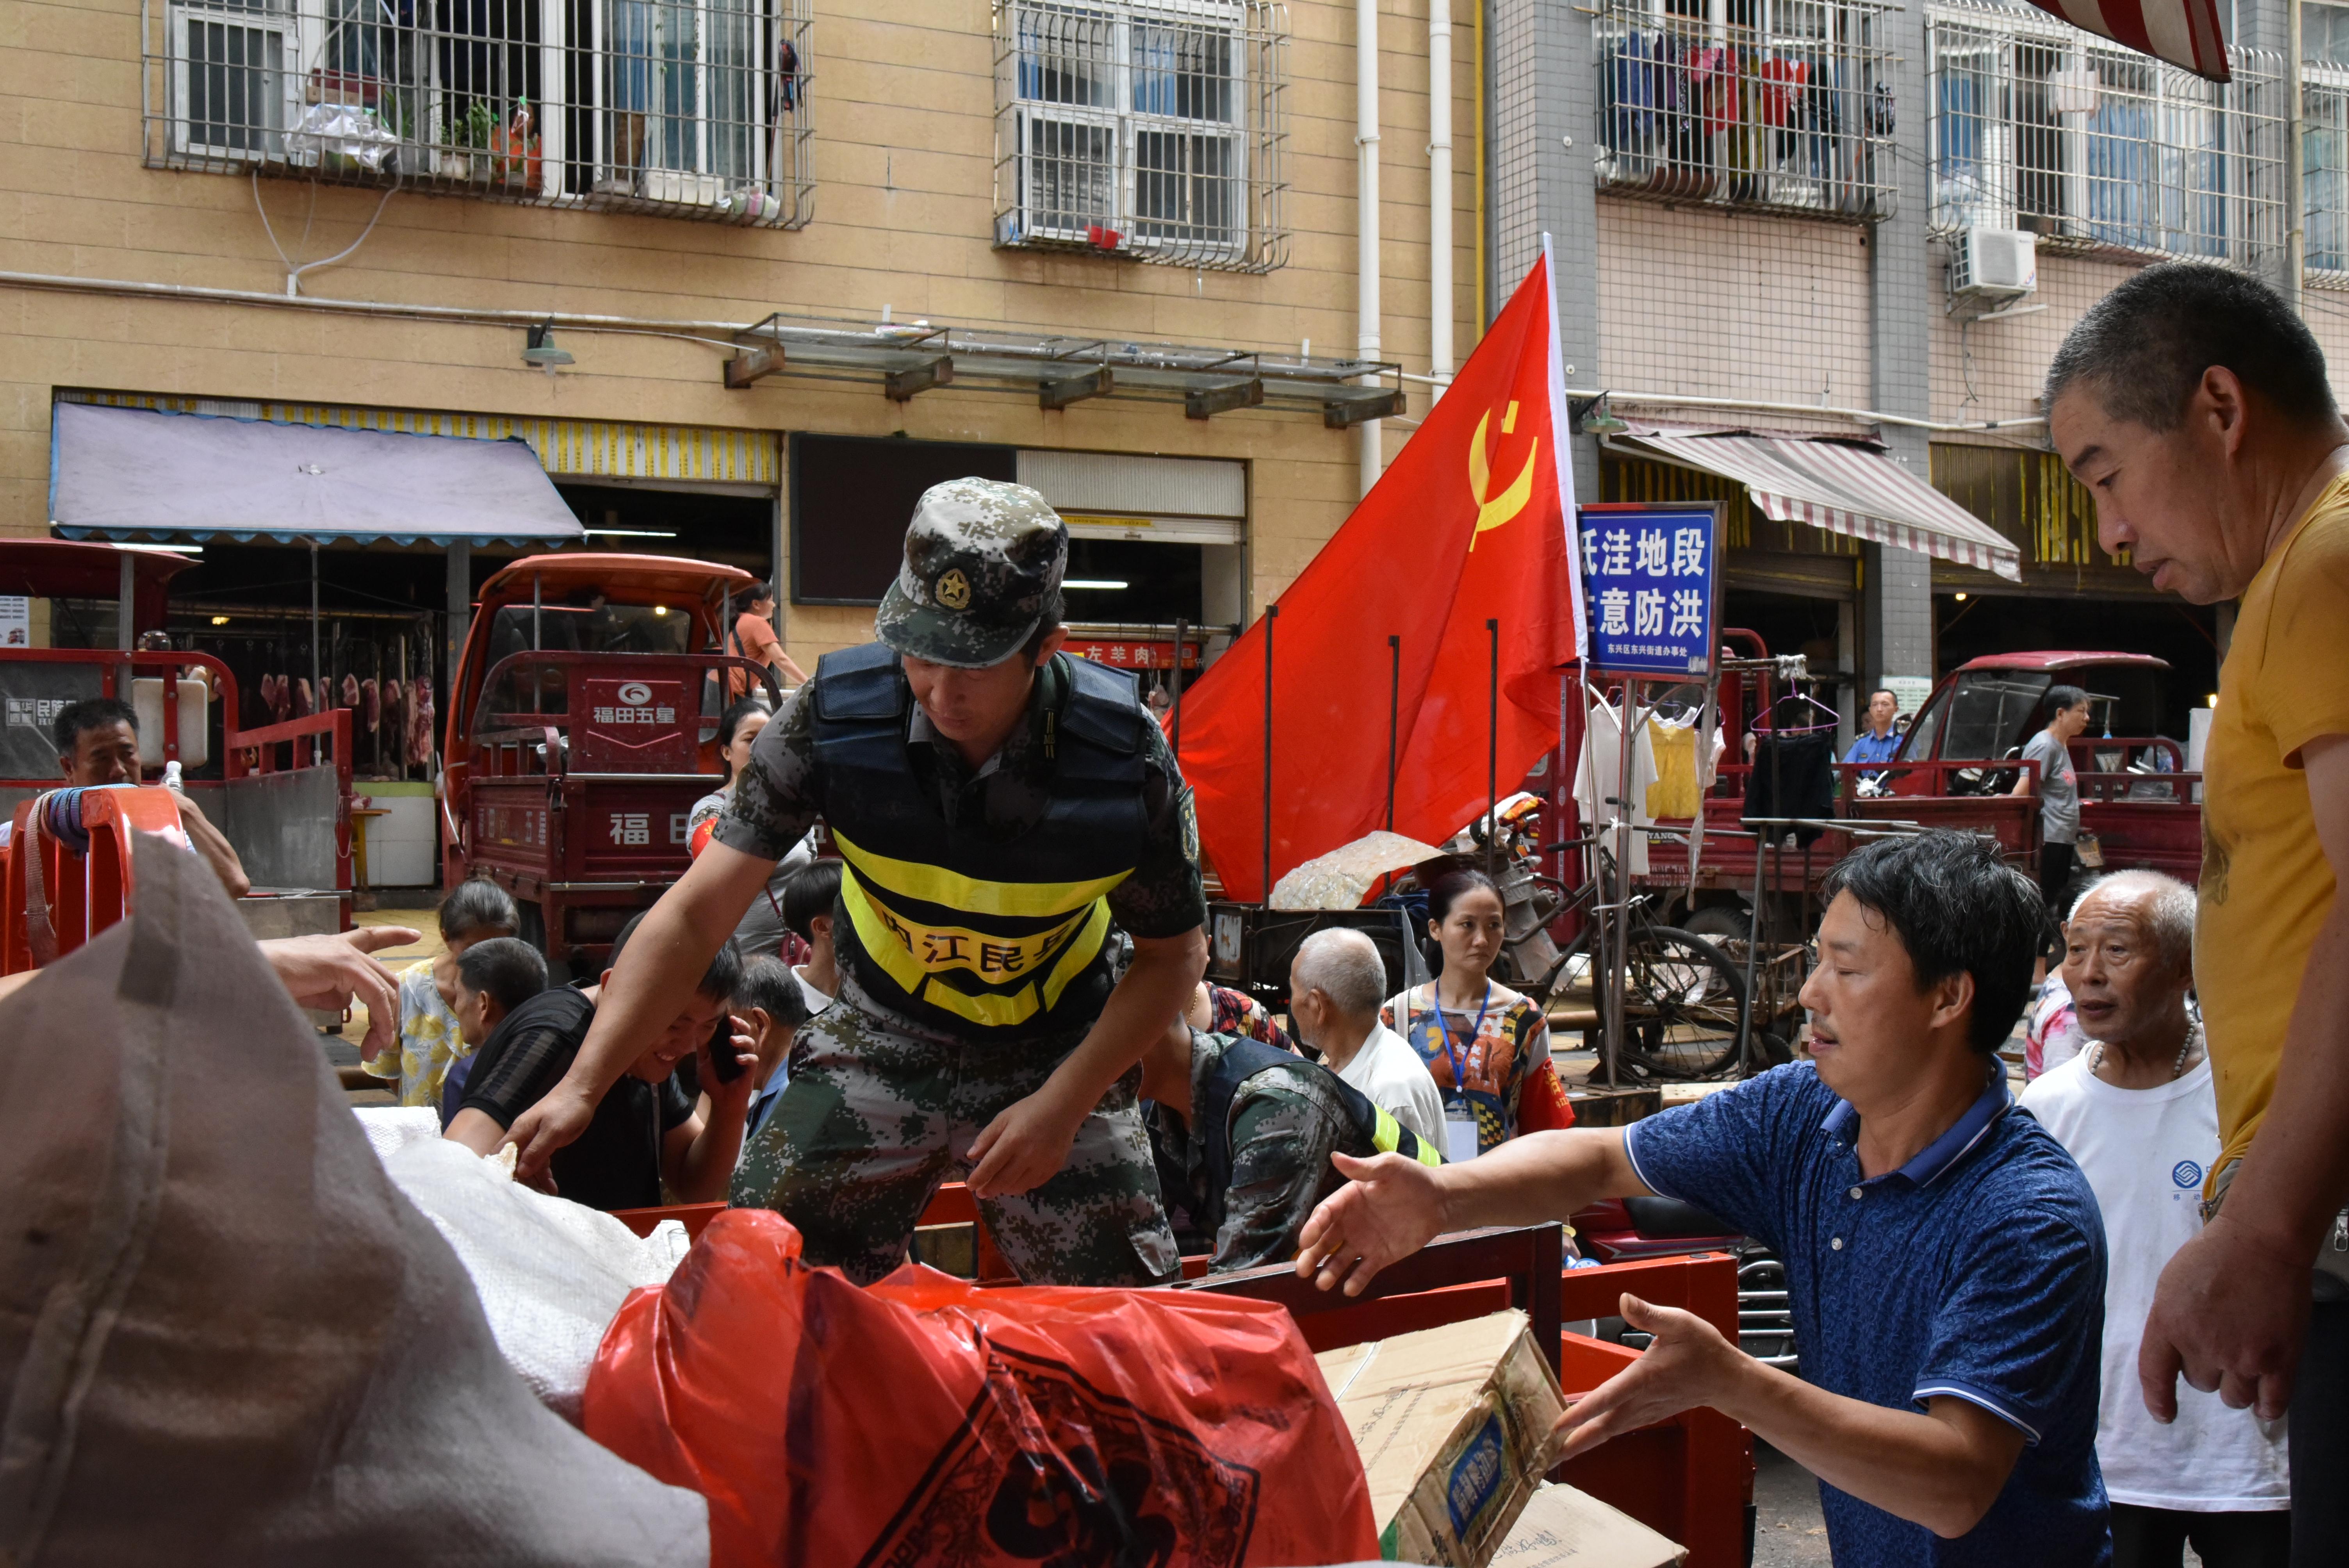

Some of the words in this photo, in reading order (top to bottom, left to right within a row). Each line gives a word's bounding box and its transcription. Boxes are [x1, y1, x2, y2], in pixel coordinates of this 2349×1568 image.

[1608, 643, 1688, 657] 东兴区东兴街道办事处
[593, 707, 675, 724] 福田五星
